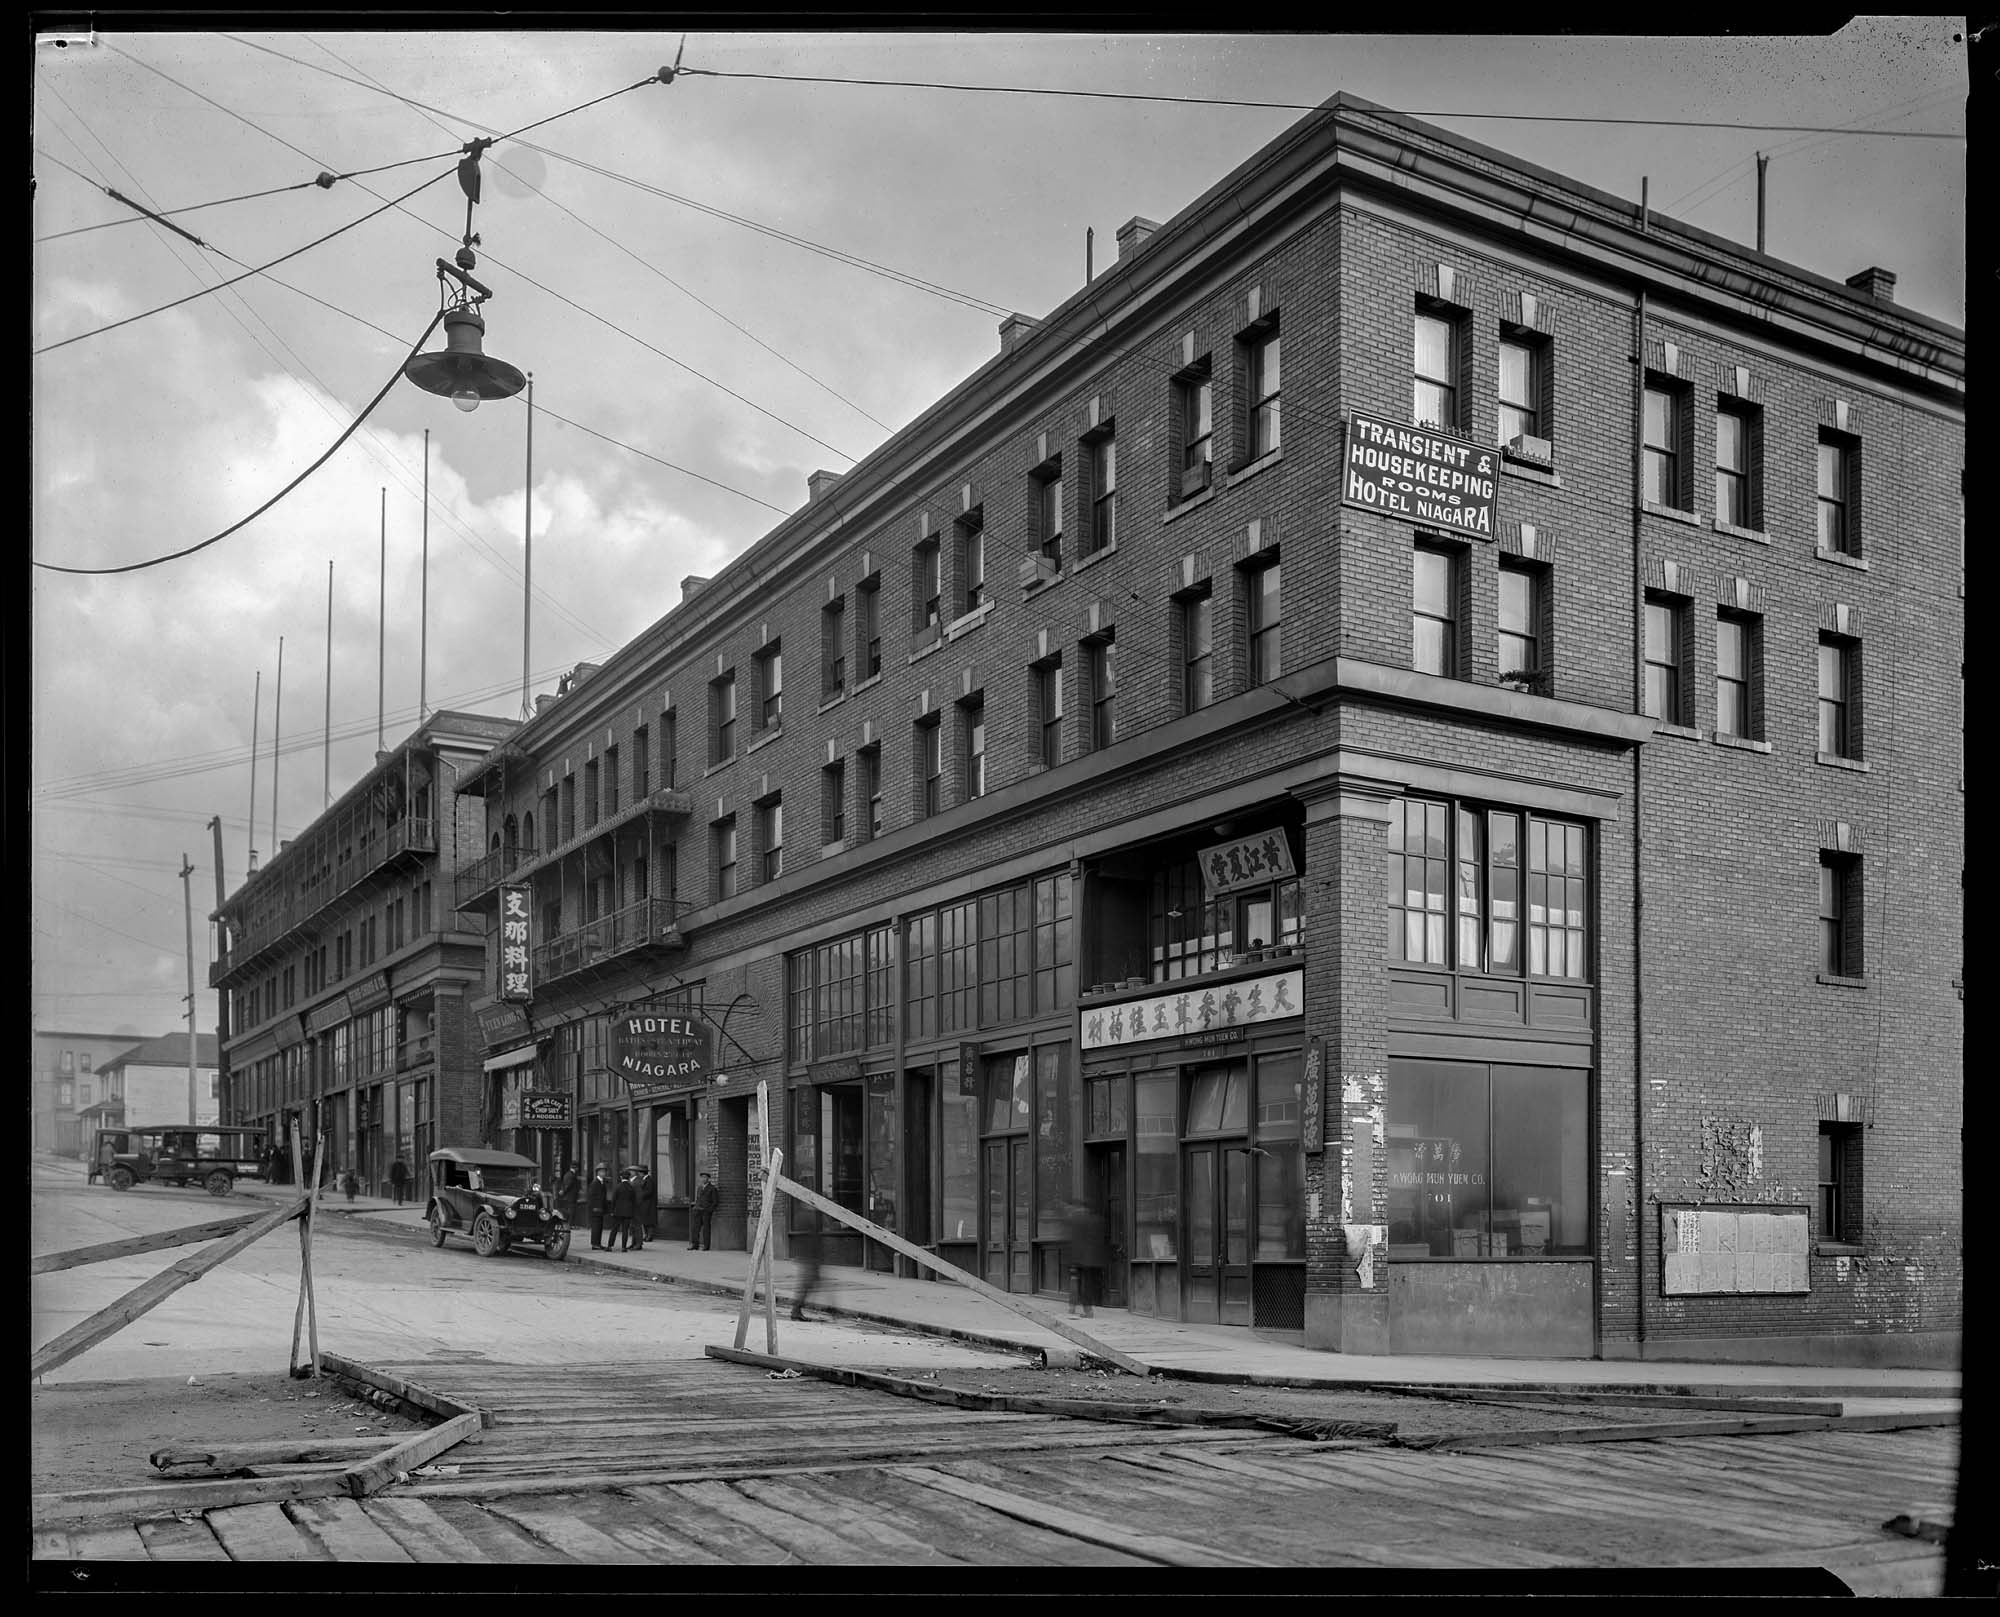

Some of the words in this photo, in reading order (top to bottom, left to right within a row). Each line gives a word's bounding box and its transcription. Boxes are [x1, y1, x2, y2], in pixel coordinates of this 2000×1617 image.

[1356, 419, 1470, 467] TRANSIENT
[1477, 455, 1492, 475] &
[1351, 444, 1493, 499] HOUSEKEEPING
[1382, 476, 1462, 505] ROOMS
[1349, 469, 1410, 512] HOTEL
[1417, 500, 1490, 533] NIAGARA
[504, 891, 529, 994] 支那料理
[629, 1018, 695, 1036] HOTEL
[622, 1056, 701, 1077] NIAGARA
[1426, 1172, 1445, 1184] MUN
[1447, 1172, 1469, 1184] YUEN
[1471, 1174, 1486, 1185] CO.
